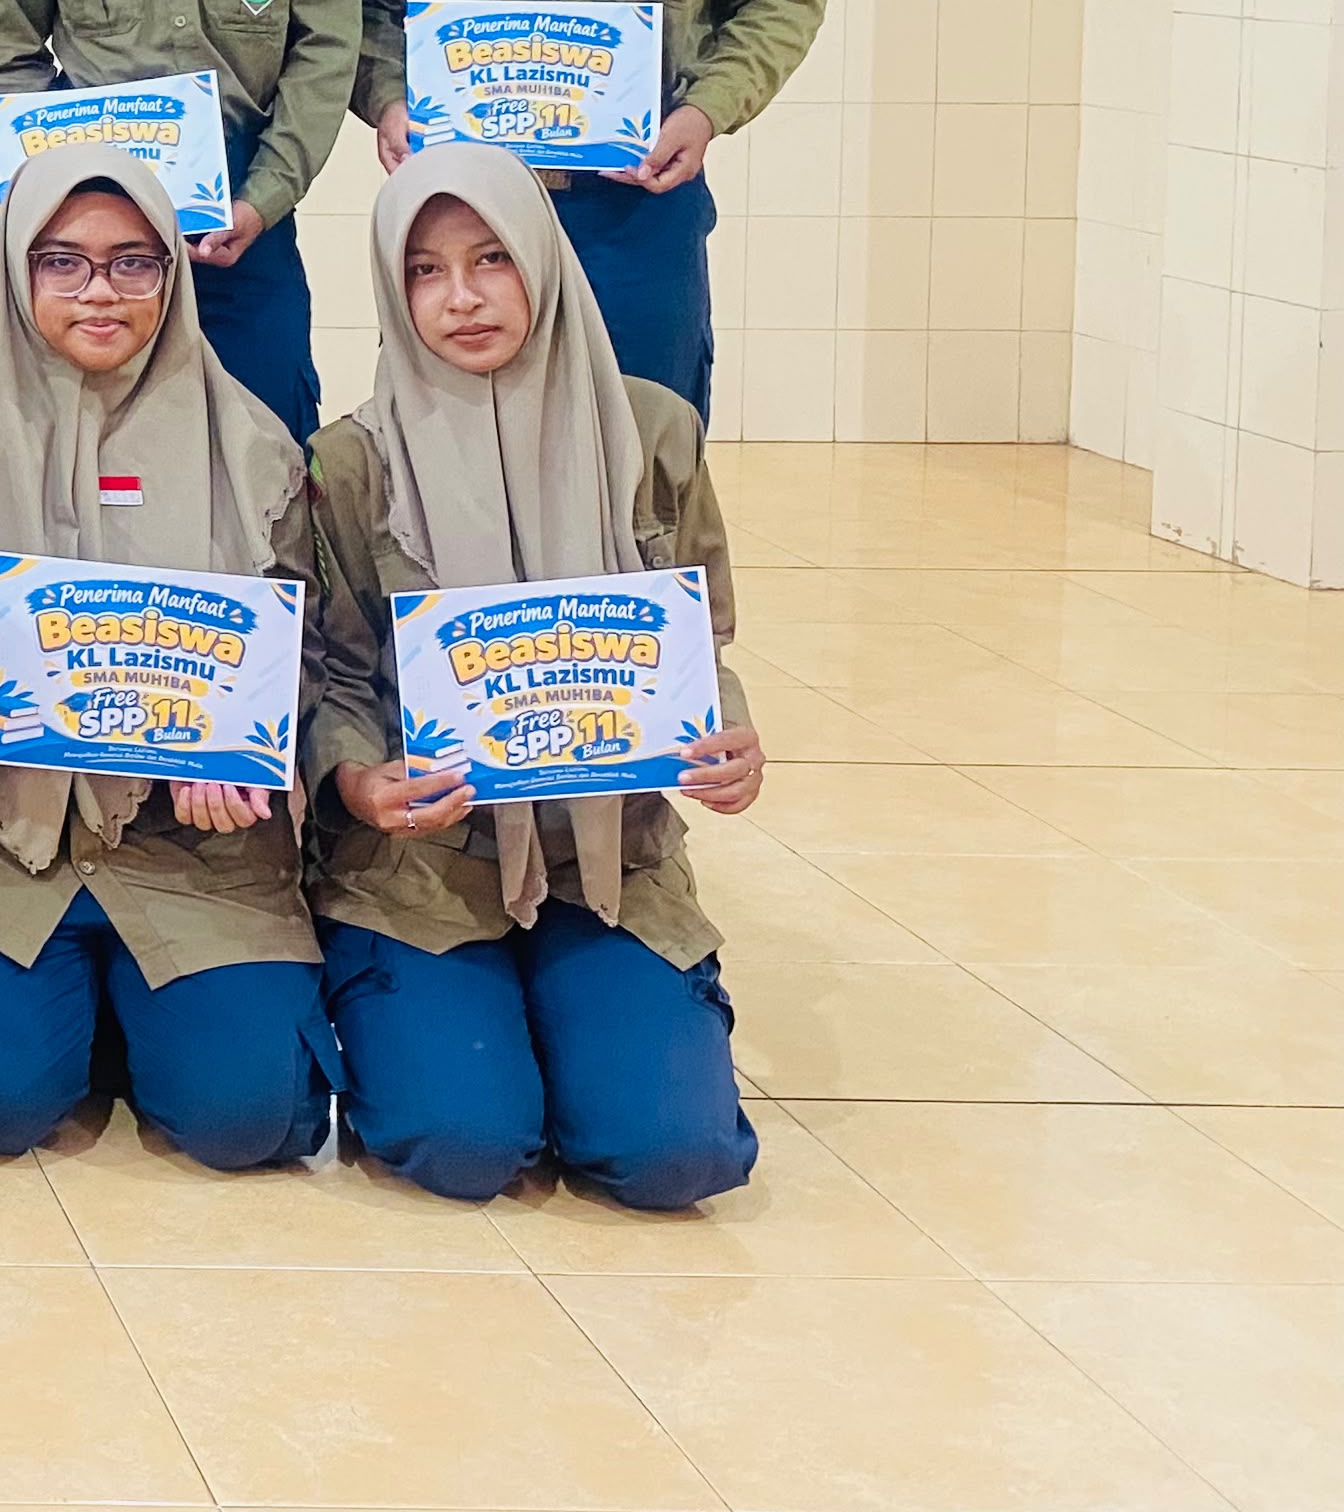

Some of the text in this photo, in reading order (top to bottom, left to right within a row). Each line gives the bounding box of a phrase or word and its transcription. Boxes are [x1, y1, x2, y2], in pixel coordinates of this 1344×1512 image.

[463, 15, 598, 38] Penerima Manfaat
[445, 34, 613, 75] Beasiswa
[470, 66, 590, 88] KL Lazismu
[484, 86, 512, 96] SMA
[36, 98, 163, 126] Penerima Manfaat
[491, 98, 527, 114] Free
[482, 104, 570, 138] SPP 11
[541, 127, 572, 138] Bulan
[20, 116, 180, 157] Beasiswa
[60, 584, 228, 619] Penerima Manfaat
[470, 598, 637, 636] Penerima Manfaat
[36, 610, 245, 668] Beasiswa
[67, 648, 215, 681] KL Lazismu
[449, 623, 660, 685] Beasiswa
[84, 671, 120, 683] SMA
[485, 663, 635, 699] KL Lazismu
[91, 688, 139, 708] Free
[504, 694, 541, 711] SMA
[78, 699, 191, 738] SPP 11
[516, 710, 562, 736] Free
[152, 728, 192, 741] Bulan
[506, 712, 618, 766] SPP 11
[582, 738, 621, 758] Bulan
